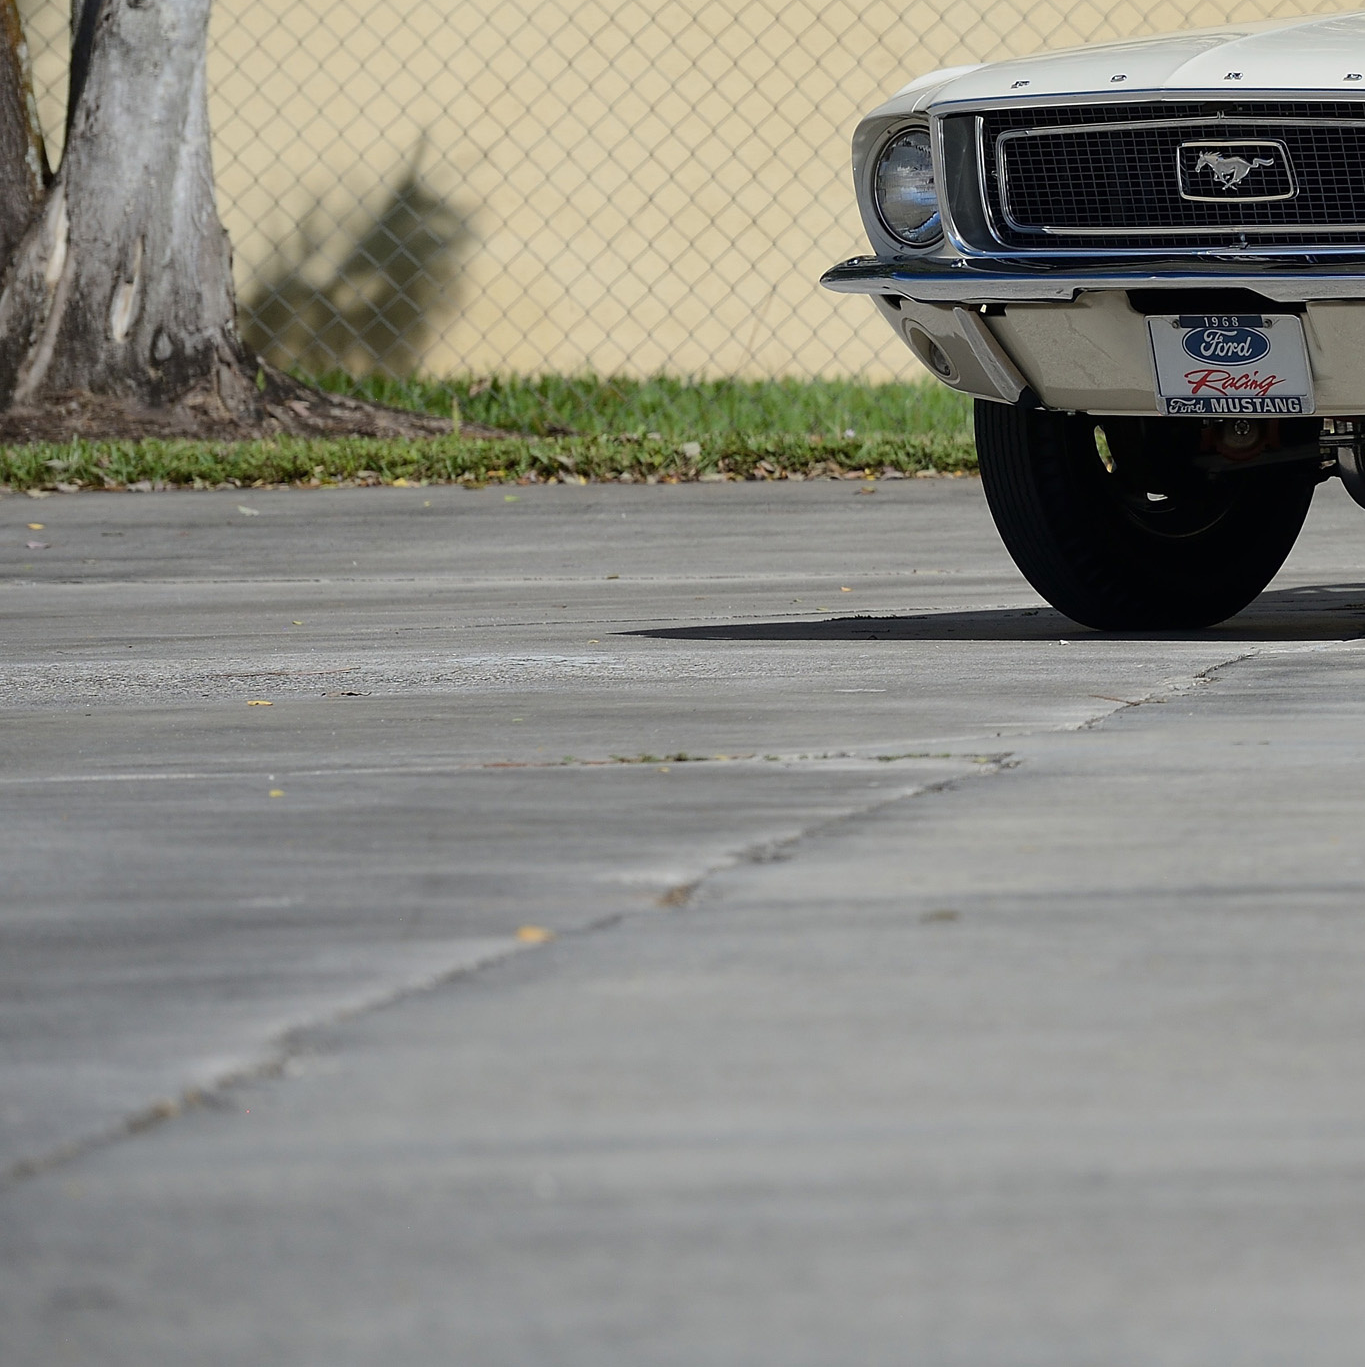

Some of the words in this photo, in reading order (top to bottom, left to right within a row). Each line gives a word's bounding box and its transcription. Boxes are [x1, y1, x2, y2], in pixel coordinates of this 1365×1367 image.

[1203, 316, 1239, 327] 1968
[1200, 329, 1252, 357] Ford
[1184, 368, 1287, 396] Racing
[1168, 398, 1207, 414] Ford
[1211, 398, 1301, 414] MUSTANG
